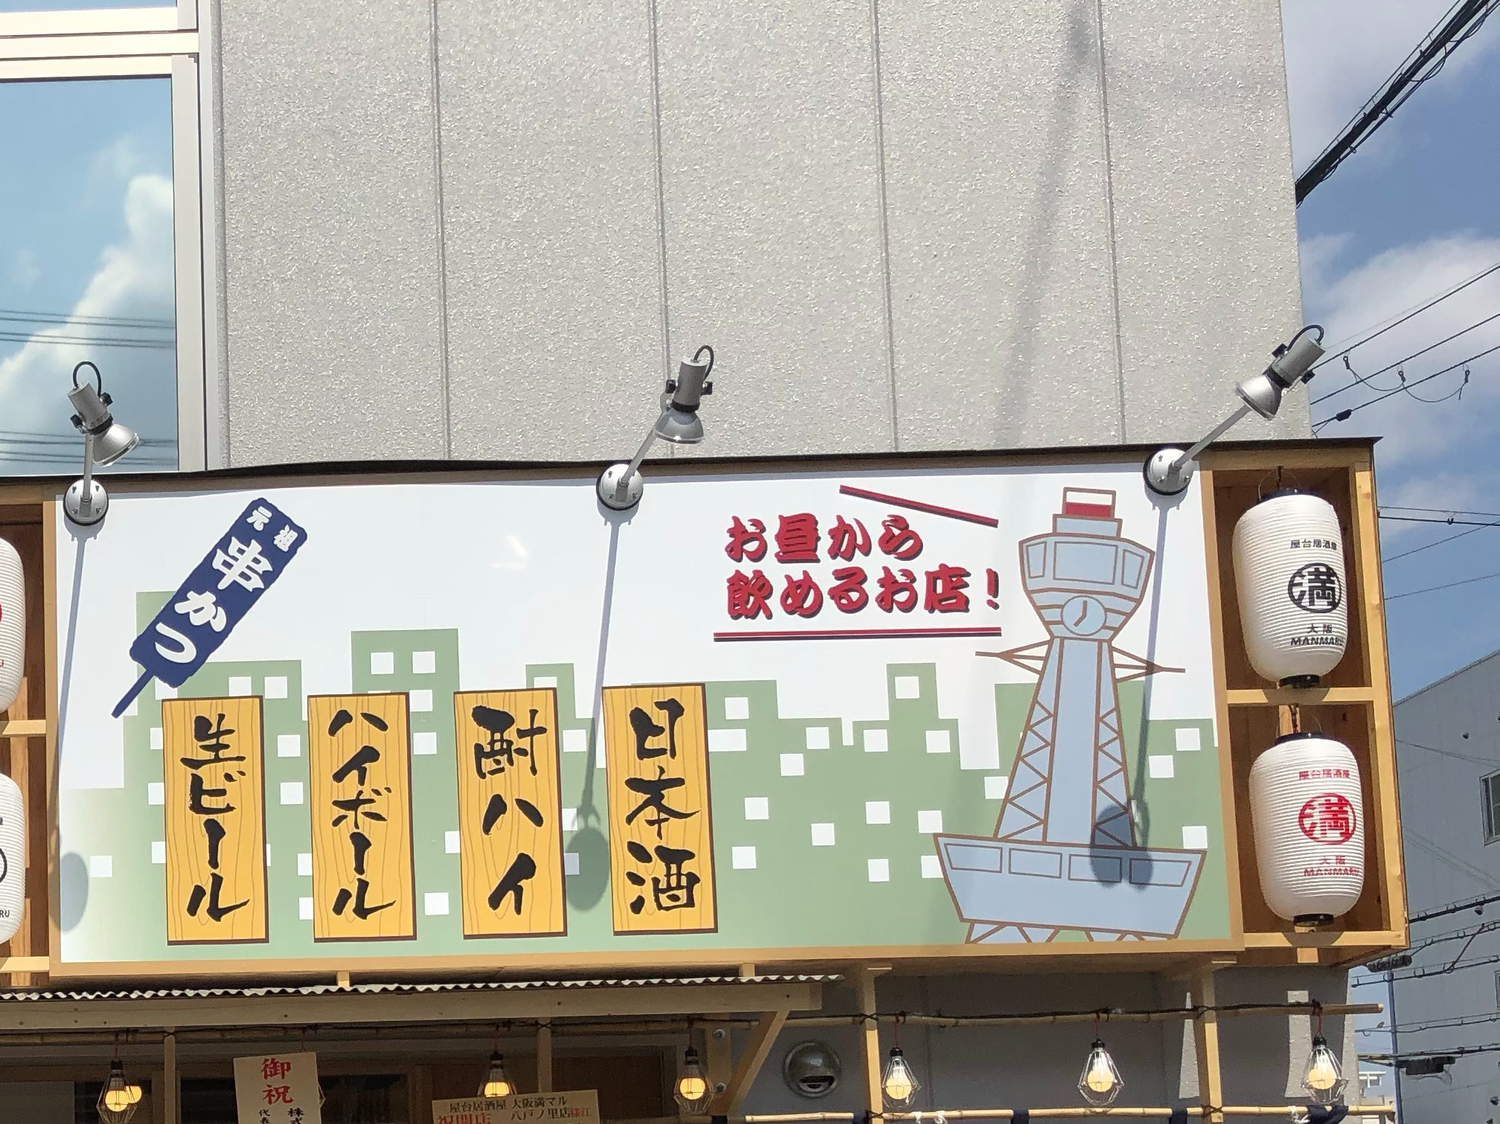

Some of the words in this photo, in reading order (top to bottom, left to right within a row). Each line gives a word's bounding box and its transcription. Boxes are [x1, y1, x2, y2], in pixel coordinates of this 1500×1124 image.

[246, 506, 299, 554] 元祖
[725, 512, 924, 565] お昼から
[154, 535, 274, 664] 串かつ
[725, 565, 1000, 621] 飲めるお店!
[1287, 561, 1343, 613] 満
[1307, 623, 1333, 634] 大阪
[180, 713, 250, 923] 生ビール
[327, 708, 396, 922] ハイボール
[471, 705, 548, 916] 酎ハイ
[625, 697, 702, 916] 日本酒
[1298, 791, 1358, 845] 満
[1320, 855, 1346, 866] 大阪
[260, 1057, 295, 1105] 御祝
[450, 1099, 507, 1113] 屋台居酒屋
[511, 1096, 568, 1110] 大阪満マル
